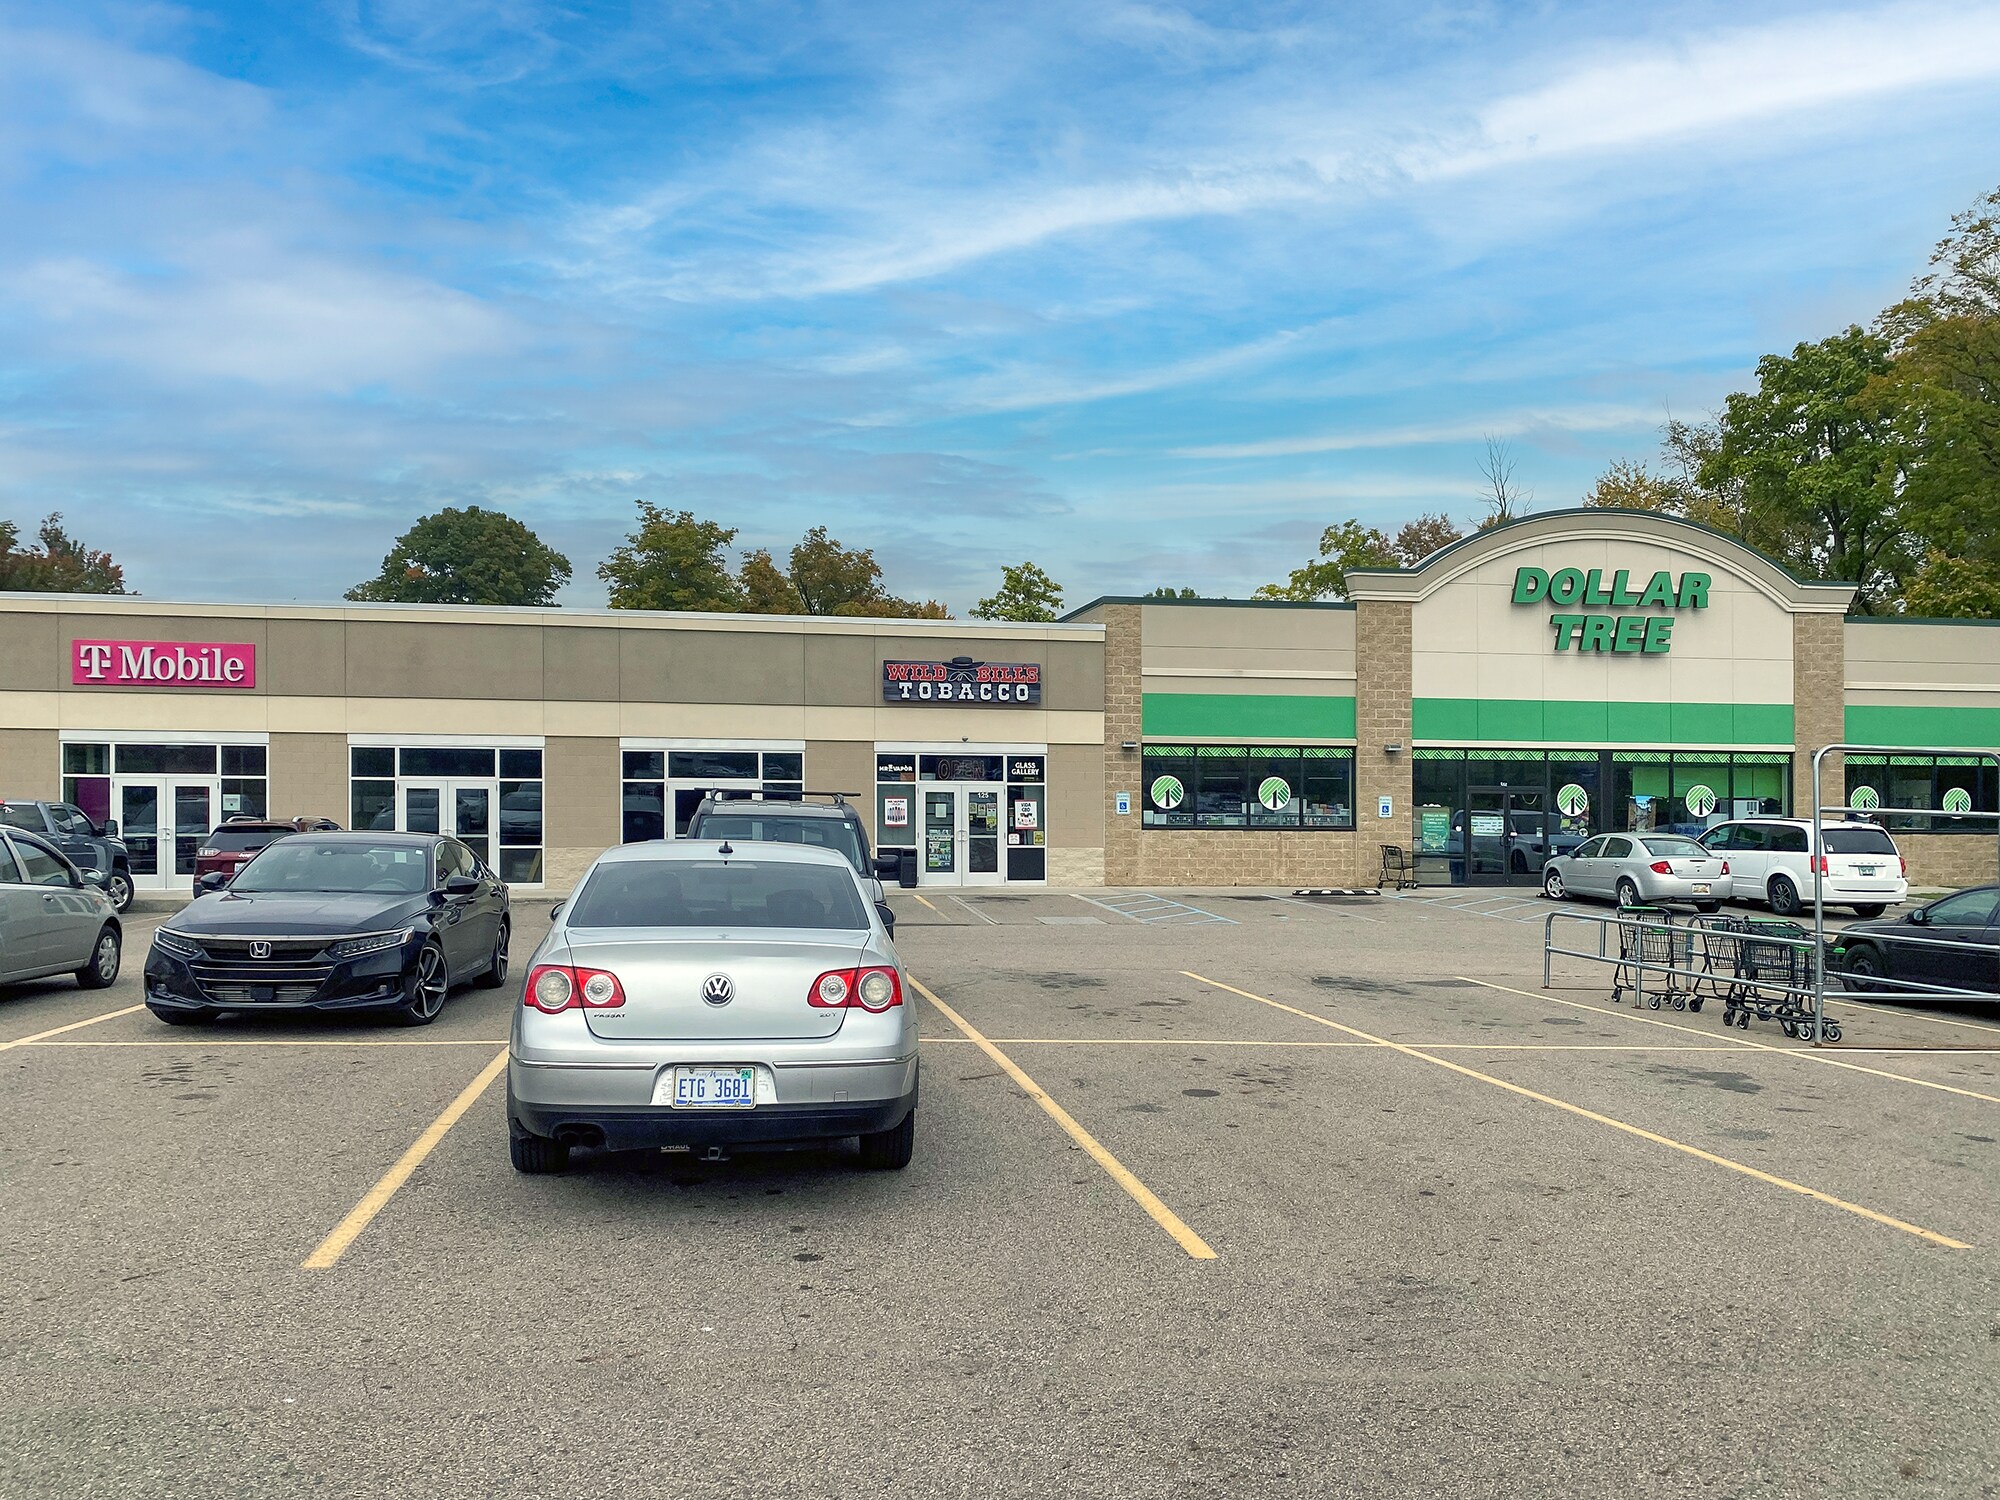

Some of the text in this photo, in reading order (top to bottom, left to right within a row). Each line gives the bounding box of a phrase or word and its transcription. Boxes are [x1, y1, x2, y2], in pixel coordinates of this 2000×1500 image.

[1511, 566, 1712, 609] DOLLAR
[1550, 613, 1675, 653] TREE
[886, 663, 1039, 684] WILD BILL'S
[898, 682, 1029, 701] TOBACCO
[938, 758, 986, 780] OPEN
[679, 1078, 705, 1098] ETG
[715, 1078, 749, 1098] 3681
